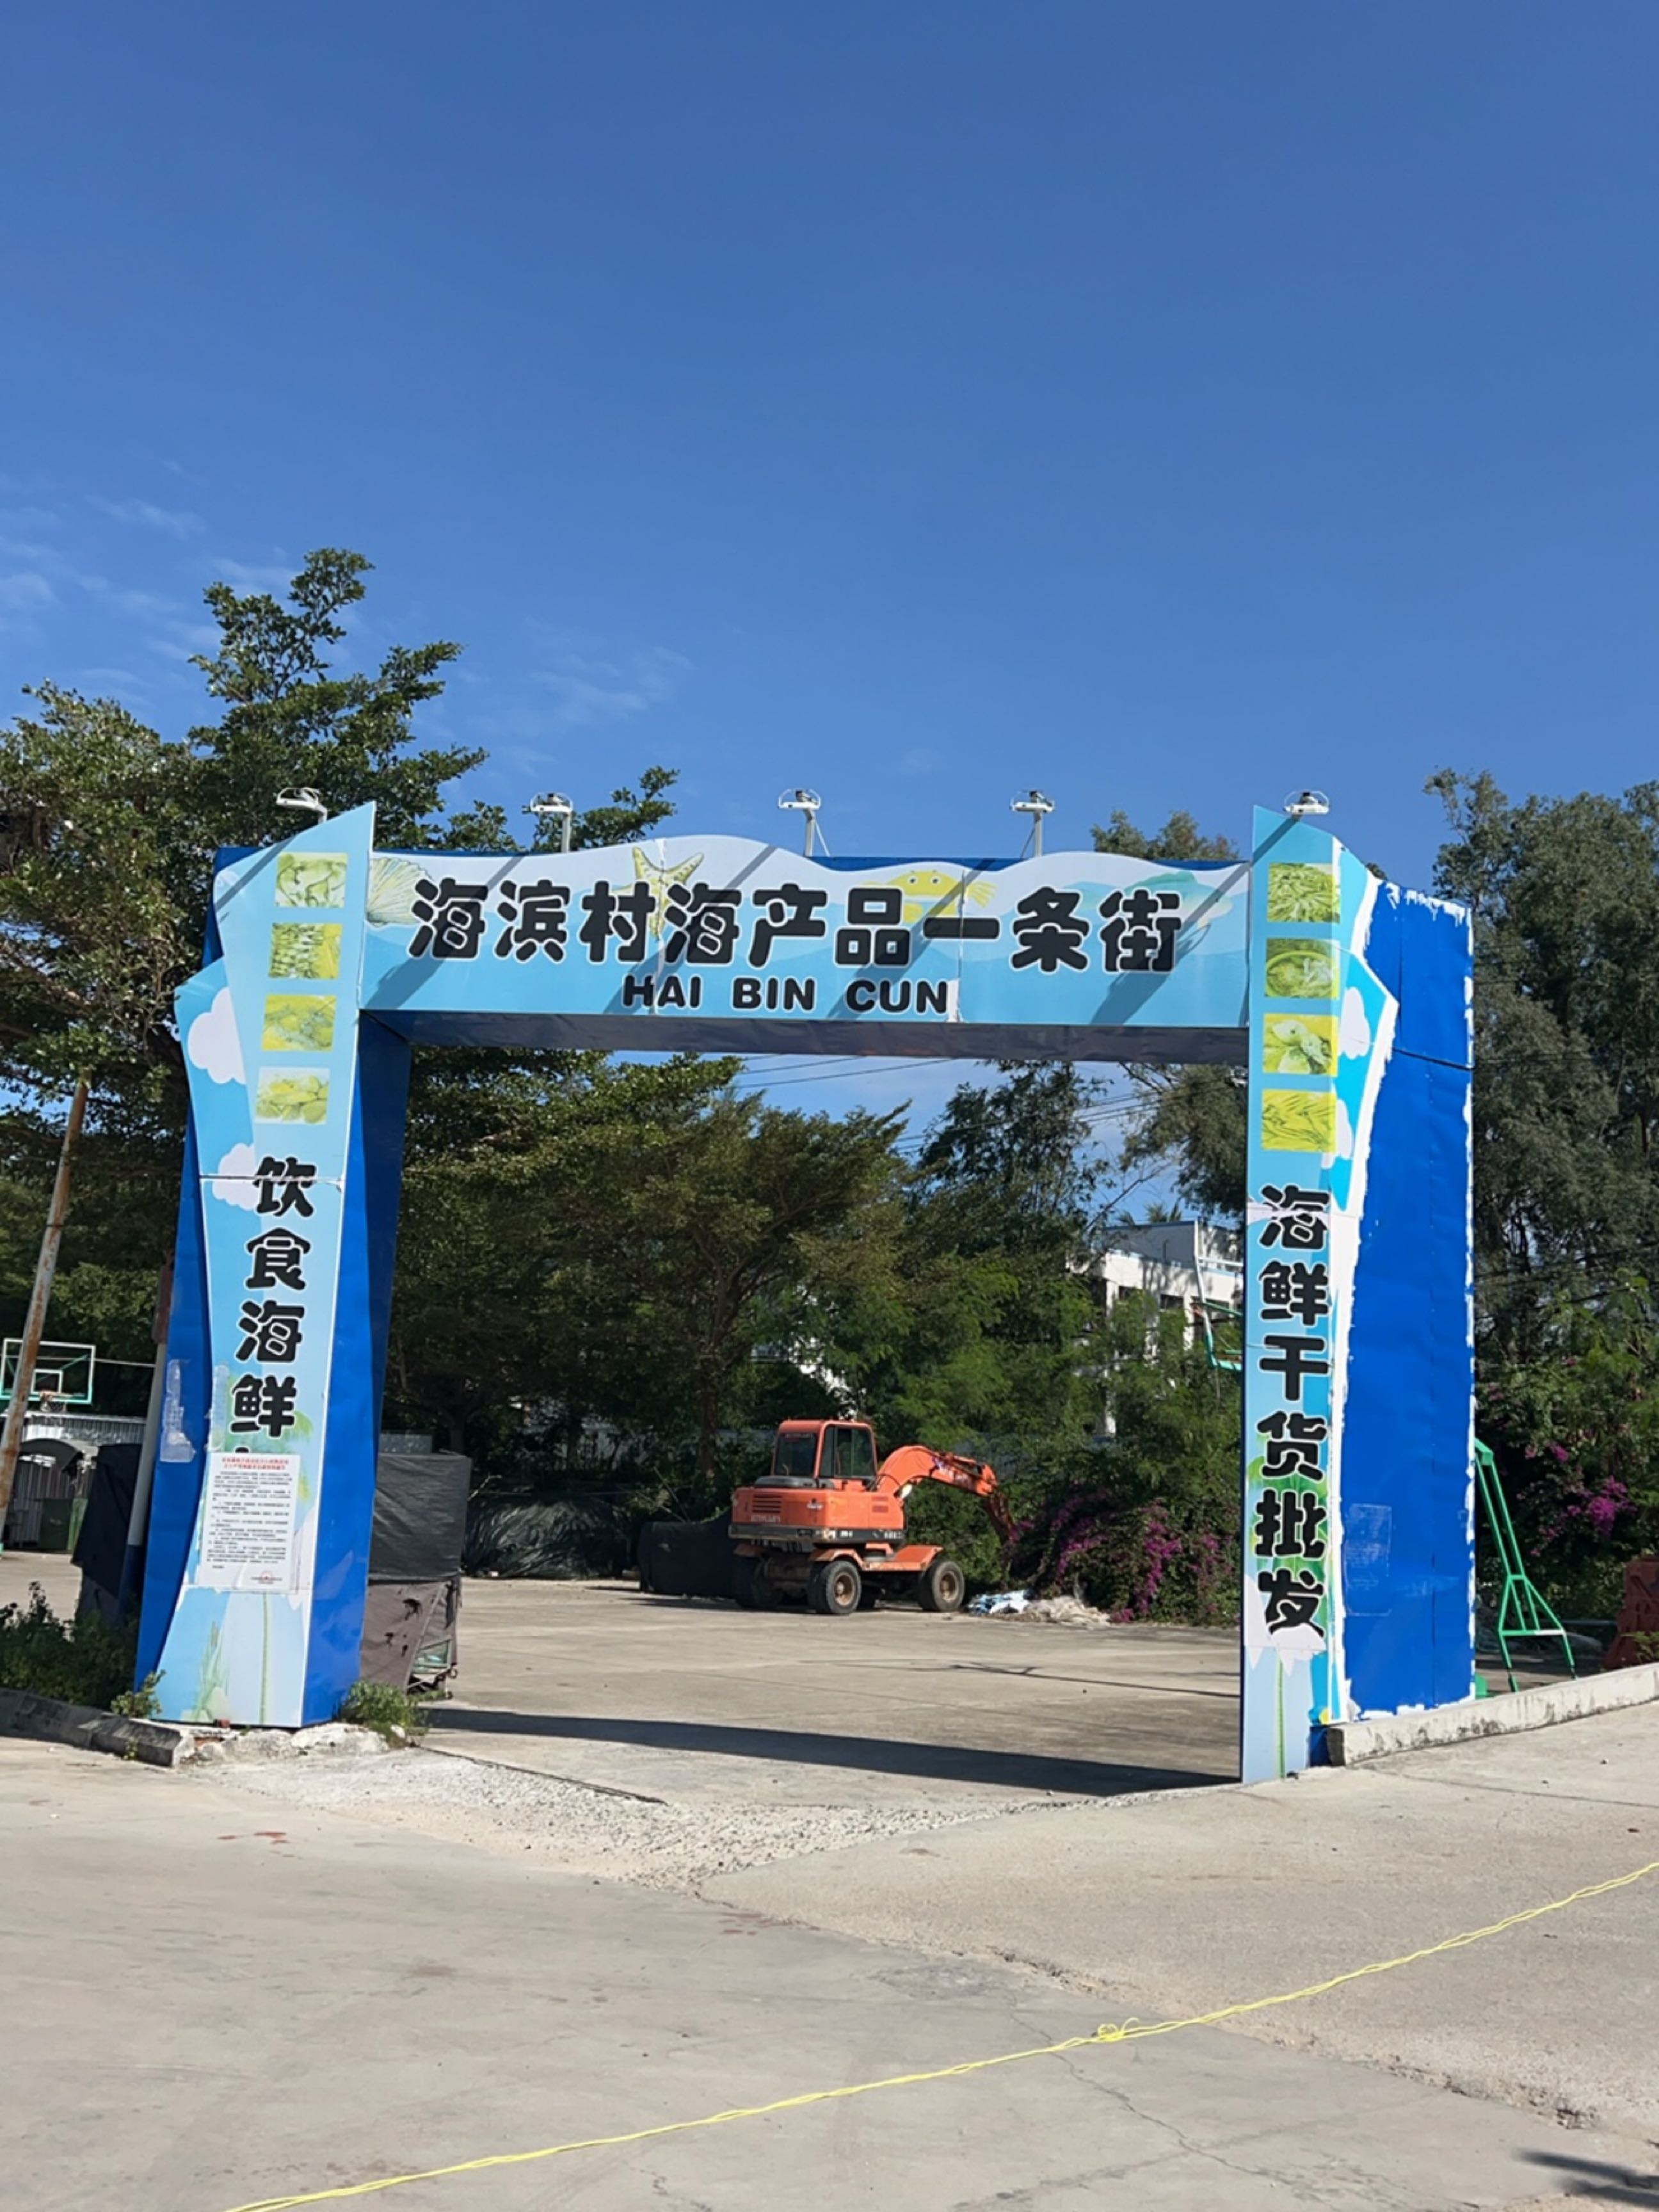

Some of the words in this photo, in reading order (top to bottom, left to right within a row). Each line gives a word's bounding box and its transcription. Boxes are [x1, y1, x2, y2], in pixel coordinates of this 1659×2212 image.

[408, 877, 1182, 973] 海滨村海产品一条街
[622, 974, 702, 1009] HAI
[732, 977, 815, 1011] BIN
[846, 979, 949, 1014] CUN
[230, 1156, 316, 1453] 饮食海鲜
[1254, 1184, 1330, 1639] 海鲜干货批发
